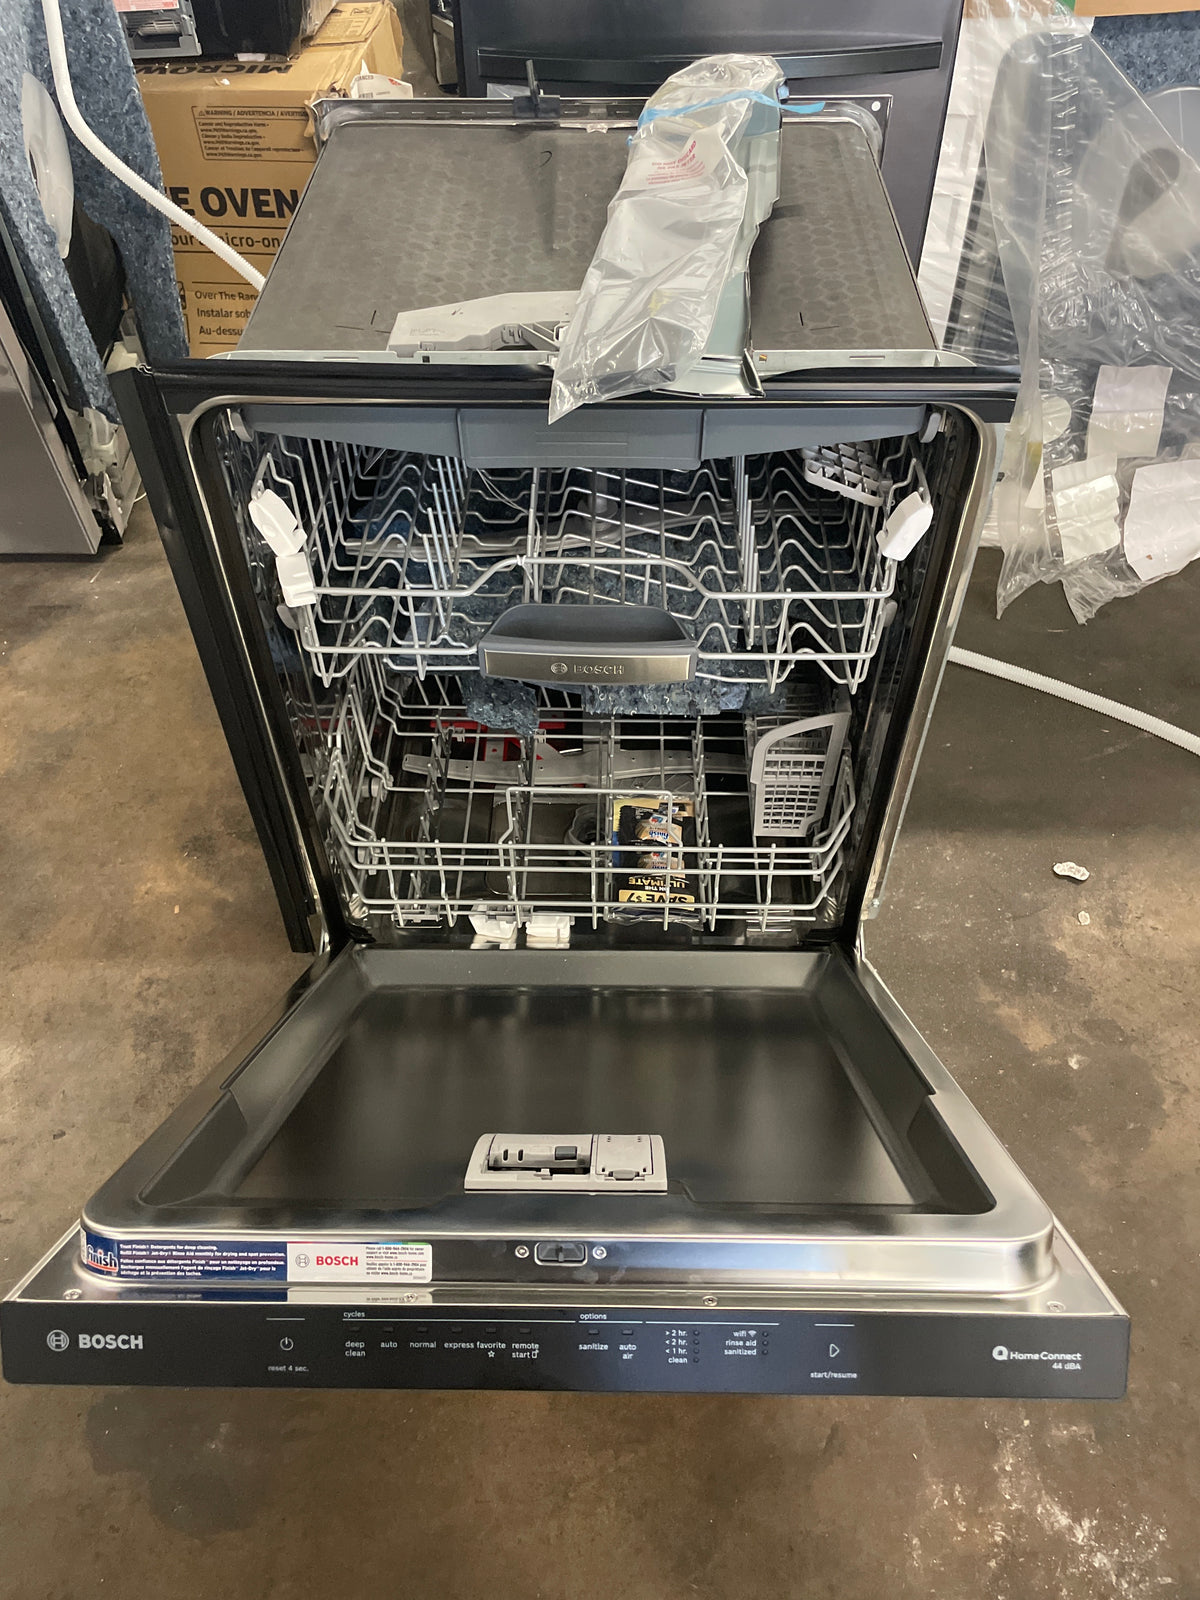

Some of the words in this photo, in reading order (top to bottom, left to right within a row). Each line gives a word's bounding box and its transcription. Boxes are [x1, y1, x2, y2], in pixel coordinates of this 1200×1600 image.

[165, 187, 195, 217] E
[200, 187, 299, 218] OVEN
[218, 232, 281, 248] icro-on
[195, 290, 217, 300] Over
[218, 291, 237, 301] The
[197, 308, 233, 318] Instalar
[573, 664, 625, 675] BOSCH
[86, 1244, 119, 1269] finish
[316, 1256, 359, 1266] BOSCH
[343, 1310, 366, 1319] cycles
[579, 1313, 607, 1321] options
[733, 1329, 747, 1337] wifi
[78, 1333, 144, 1350] BOSCH
[345, 1340, 365, 1349] deep
[409, 1341, 436, 1349] normal
[444, 1341, 475, 1350] express
[476, 1341, 506, 1349] favorite
[725, 1339, 743, 1347] rinse
[745, 1339, 757, 1347] aid
[511, 1342, 540, 1350] remote
[579, 1343, 609, 1351] sanitize
[345, 1349, 366, 1357] clean
[511, 1351, 531, 1359] start
[622, 1352, 634, 1360] air
[724, 1348, 757, 1356] sanitized
[668, 1356, 688, 1364] clean
[267, 1364, 287, 1372] reset
[1051, 1362, 1063, 1370] 44
[1064, 1362, 1082, 1371] dBA
[810, 1371, 858, 1379] start/resume
